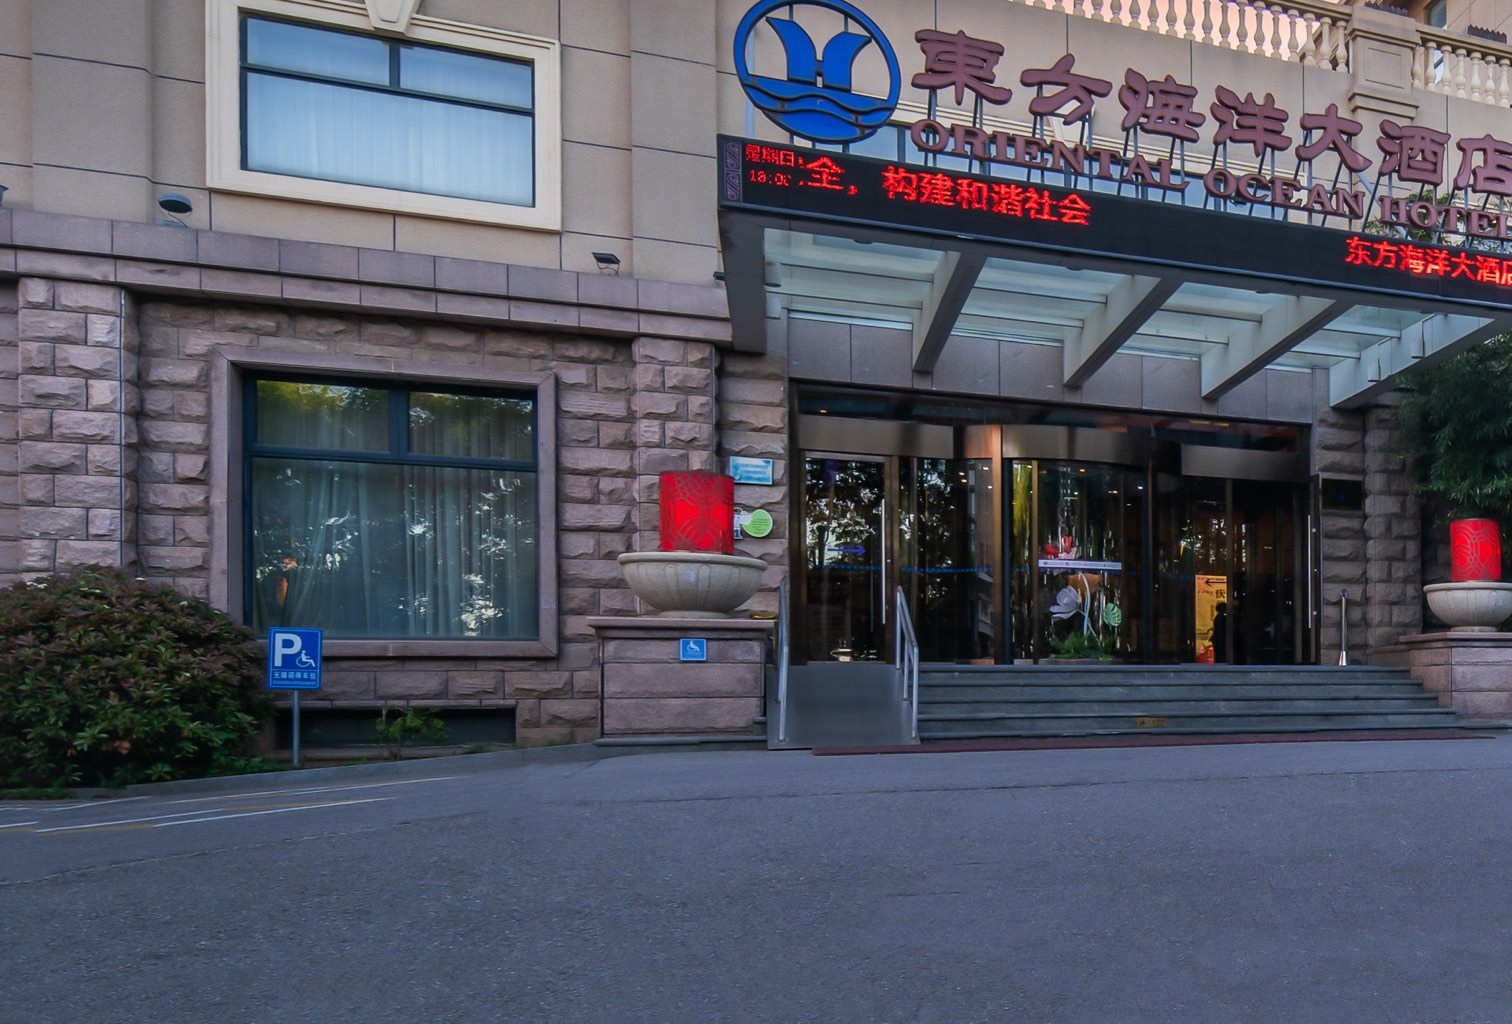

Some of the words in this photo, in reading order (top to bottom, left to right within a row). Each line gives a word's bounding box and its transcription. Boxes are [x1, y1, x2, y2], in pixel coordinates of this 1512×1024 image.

[910, 118, 1189, 192] ORIENTAL
[1203, 167, 1366, 220] OCEAN
[274, 632, 302, 667] P
